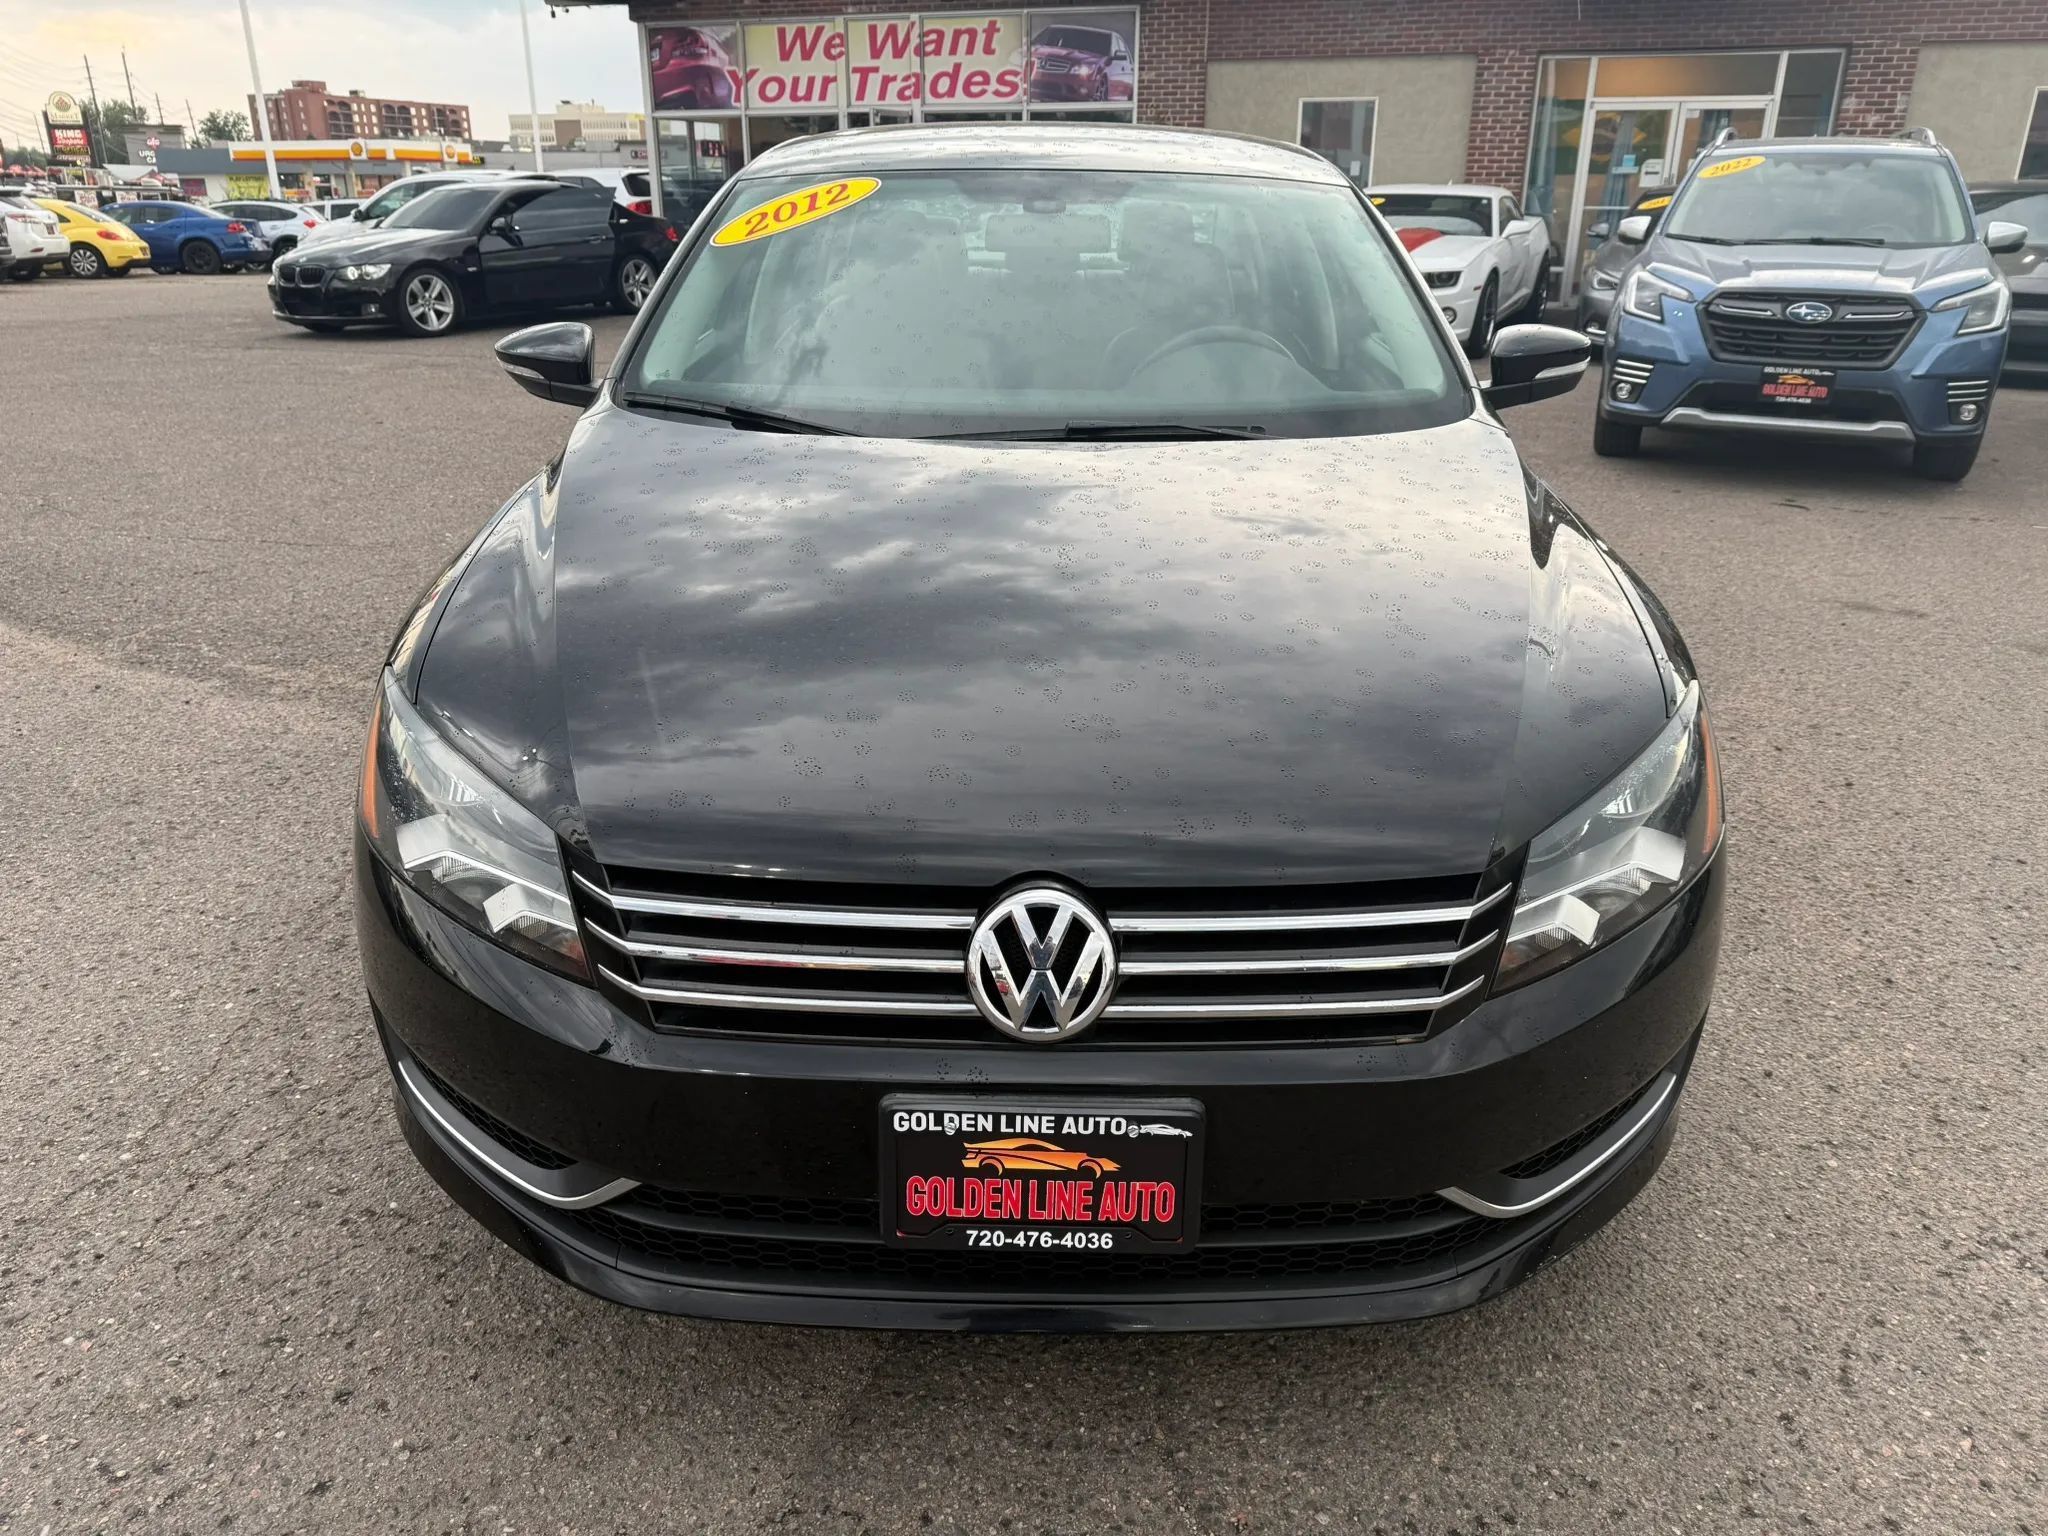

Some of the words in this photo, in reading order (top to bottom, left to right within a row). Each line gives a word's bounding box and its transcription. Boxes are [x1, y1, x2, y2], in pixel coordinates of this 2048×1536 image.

[776, 25, 846, 62] We
[867, 19, 1001, 60] Want
[726, 67, 838, 104] Your
[851, 58, 1034, 102] Trades!
[1710, 158, 1752, 176] 2022
[744, 183, 850, 238] 2012
[893, 1111, 993, 1133] GOLDEN
[1001, 1114, 1055, 1135] LINE
[1061, 1116, 1128, 1136] AUTO
[906, 1175, 1022, 1219] GOLDEN
[1028, 1179, 1093, 1221] LINE
[1098, 1181, 1176, 1223] AUTO
[966, 1230, 1114, 1250] 720-476-4036
